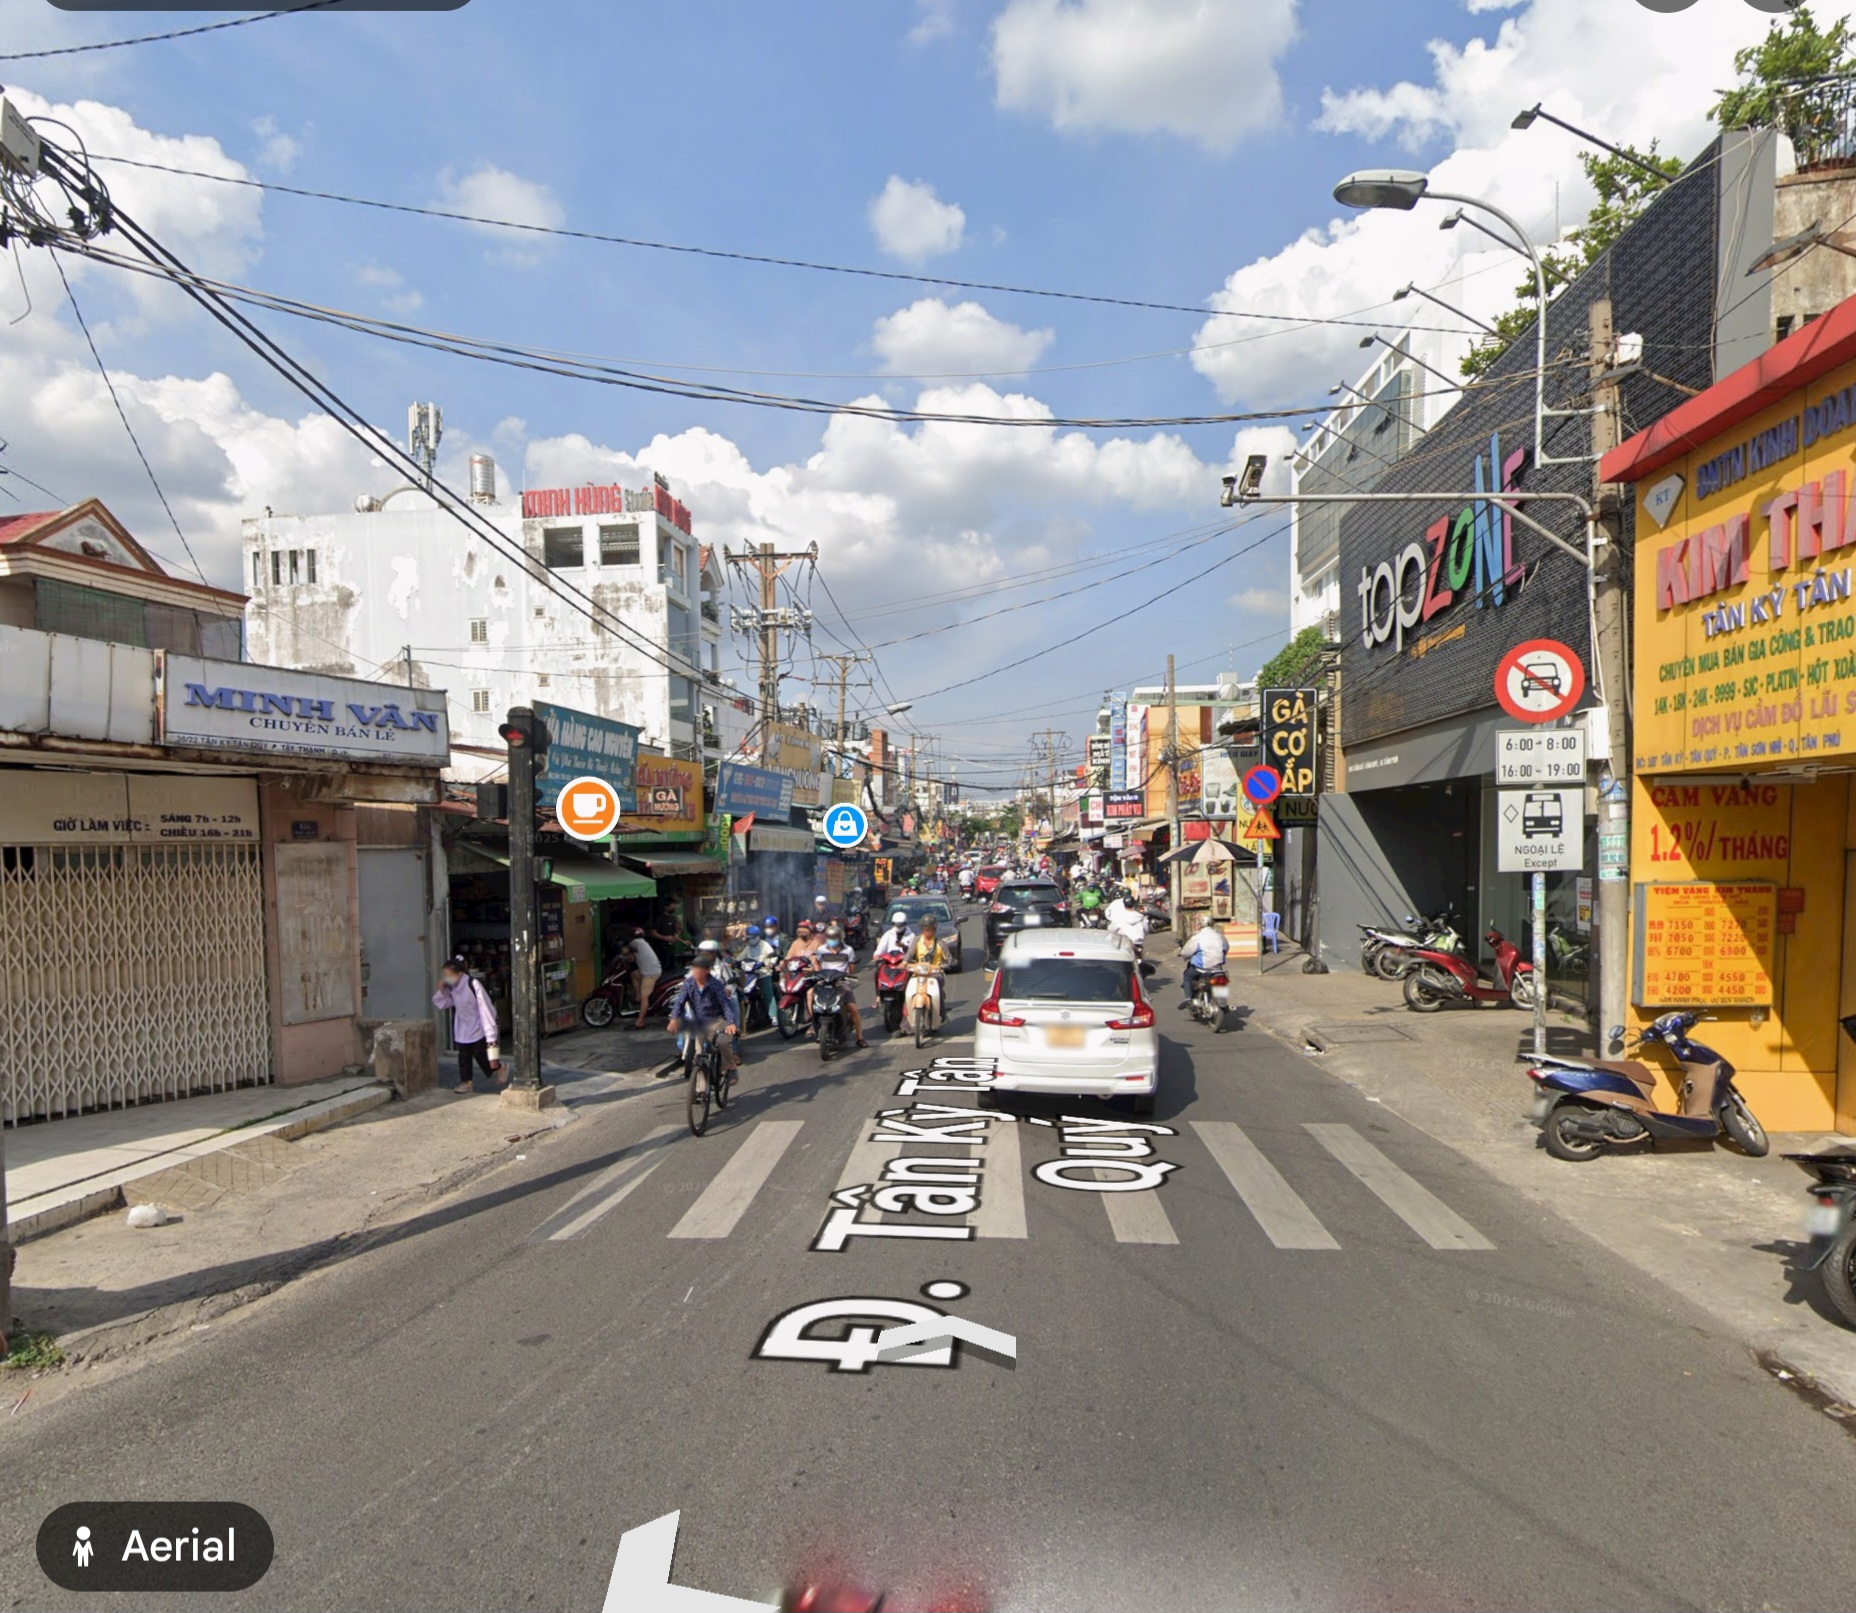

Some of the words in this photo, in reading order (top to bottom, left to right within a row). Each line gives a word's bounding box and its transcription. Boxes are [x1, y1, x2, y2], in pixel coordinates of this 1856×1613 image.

[1696, 443, 1746, 501] DNTN
[1749, 415, 1799, 474] KINH
[1655, 488, 1671, 506] KT
[1657, 512, 1750, 611] KIM
[1702, 600, 1745, 637] TÂN
[1794, 567, 1851, 611] TÂN
[1659, 655, 1695, 682] CHUYÊN
[1698, 653, 1719, 674] MUA
[1724, 642, 1744, 666] BÁN
[1748, 640, 1766, 661] GIA
[1770, 629, 1800, 656] CÔNG
[1805, 626, 1815, 647] &
[1818, 615, 1855, 645] TRAO
[1655, 696, 1668, 715] 14K
[1693, 688, 1708, 708] 24K
[1715, 681, 1736, 703] 9999
[1766, 667, 1799, 694] PLATIN
[1807, 657, 1829, 690] HỘT
[184, 683, 335, 721] MINH
[347, 703, 439, 733] VÂN
[1271, 692, 1309, 724] GÀ
[1692, 715, 1721, 741] DỊCH
[1725, 712, 1742, 736] VỤ
[1745, 698, 1777, 729] CẦM
[249, 716, 329, 735] CHUYÊN
[335, 724, 370, 739] BÁN
[375, 728, 395, 741] LẺ
[1272, 728, 1307, 756] CƠ
[1506, 738, 1533, 751] 6:00
[1547, 737, 1576, 750] 8:00
[1279, 757, 1313, 793] ẮP
[1502, 765, 1532, 777] 16:00
[1547, 763, 1580, 776] 19:00
[656, 789, 677, 801] GÀ
[80, 818, 109, 832] LÀM
[160, 813, 191, 824] SÁNG
[195, 814, 209, 823] 7h
[221, 814, 241, 823] 12h
[200, 828, 221, 838] 16h
[231, 828, 253, 838] 21h
[1515, 844, 1548, 856] NGOẠI
[1719, 829, 1788, 860] THÁNG
[1524, 859, 1557, 870] Except
[1668, 921, 1693, 930] 7150
[1668, 934, 1694, 943] 7050
[1721, 933, 1746, 943] 7220
[1666, 947, 1692, 956] 6700
[1720, 947, 1747, 956] 6900
[1665, 972, 1690, 982] 4300
[1720, 972, 1745, 982] 4550
[1666, 985, 1691, 994] 4200
[1719, 985, 1745, 994] 4450
